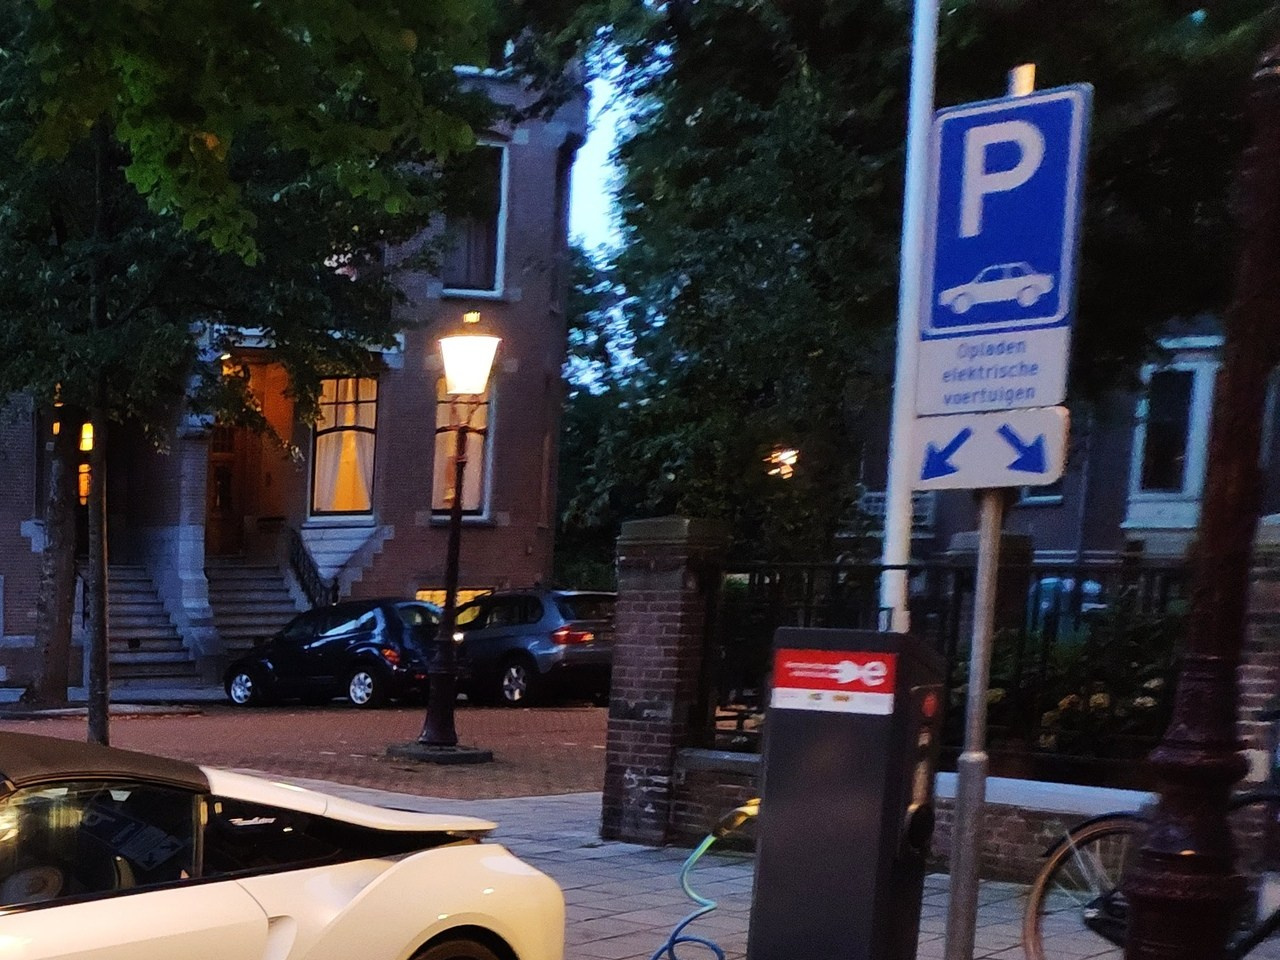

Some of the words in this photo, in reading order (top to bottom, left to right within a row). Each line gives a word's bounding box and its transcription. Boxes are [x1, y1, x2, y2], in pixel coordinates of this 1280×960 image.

[959, 120, 1046, 238] P
[958, 341, 1026, 359] Opladen
[942, 361, 1039, 382] elektrische
[943, 386, 1036, 406] voertuigen
